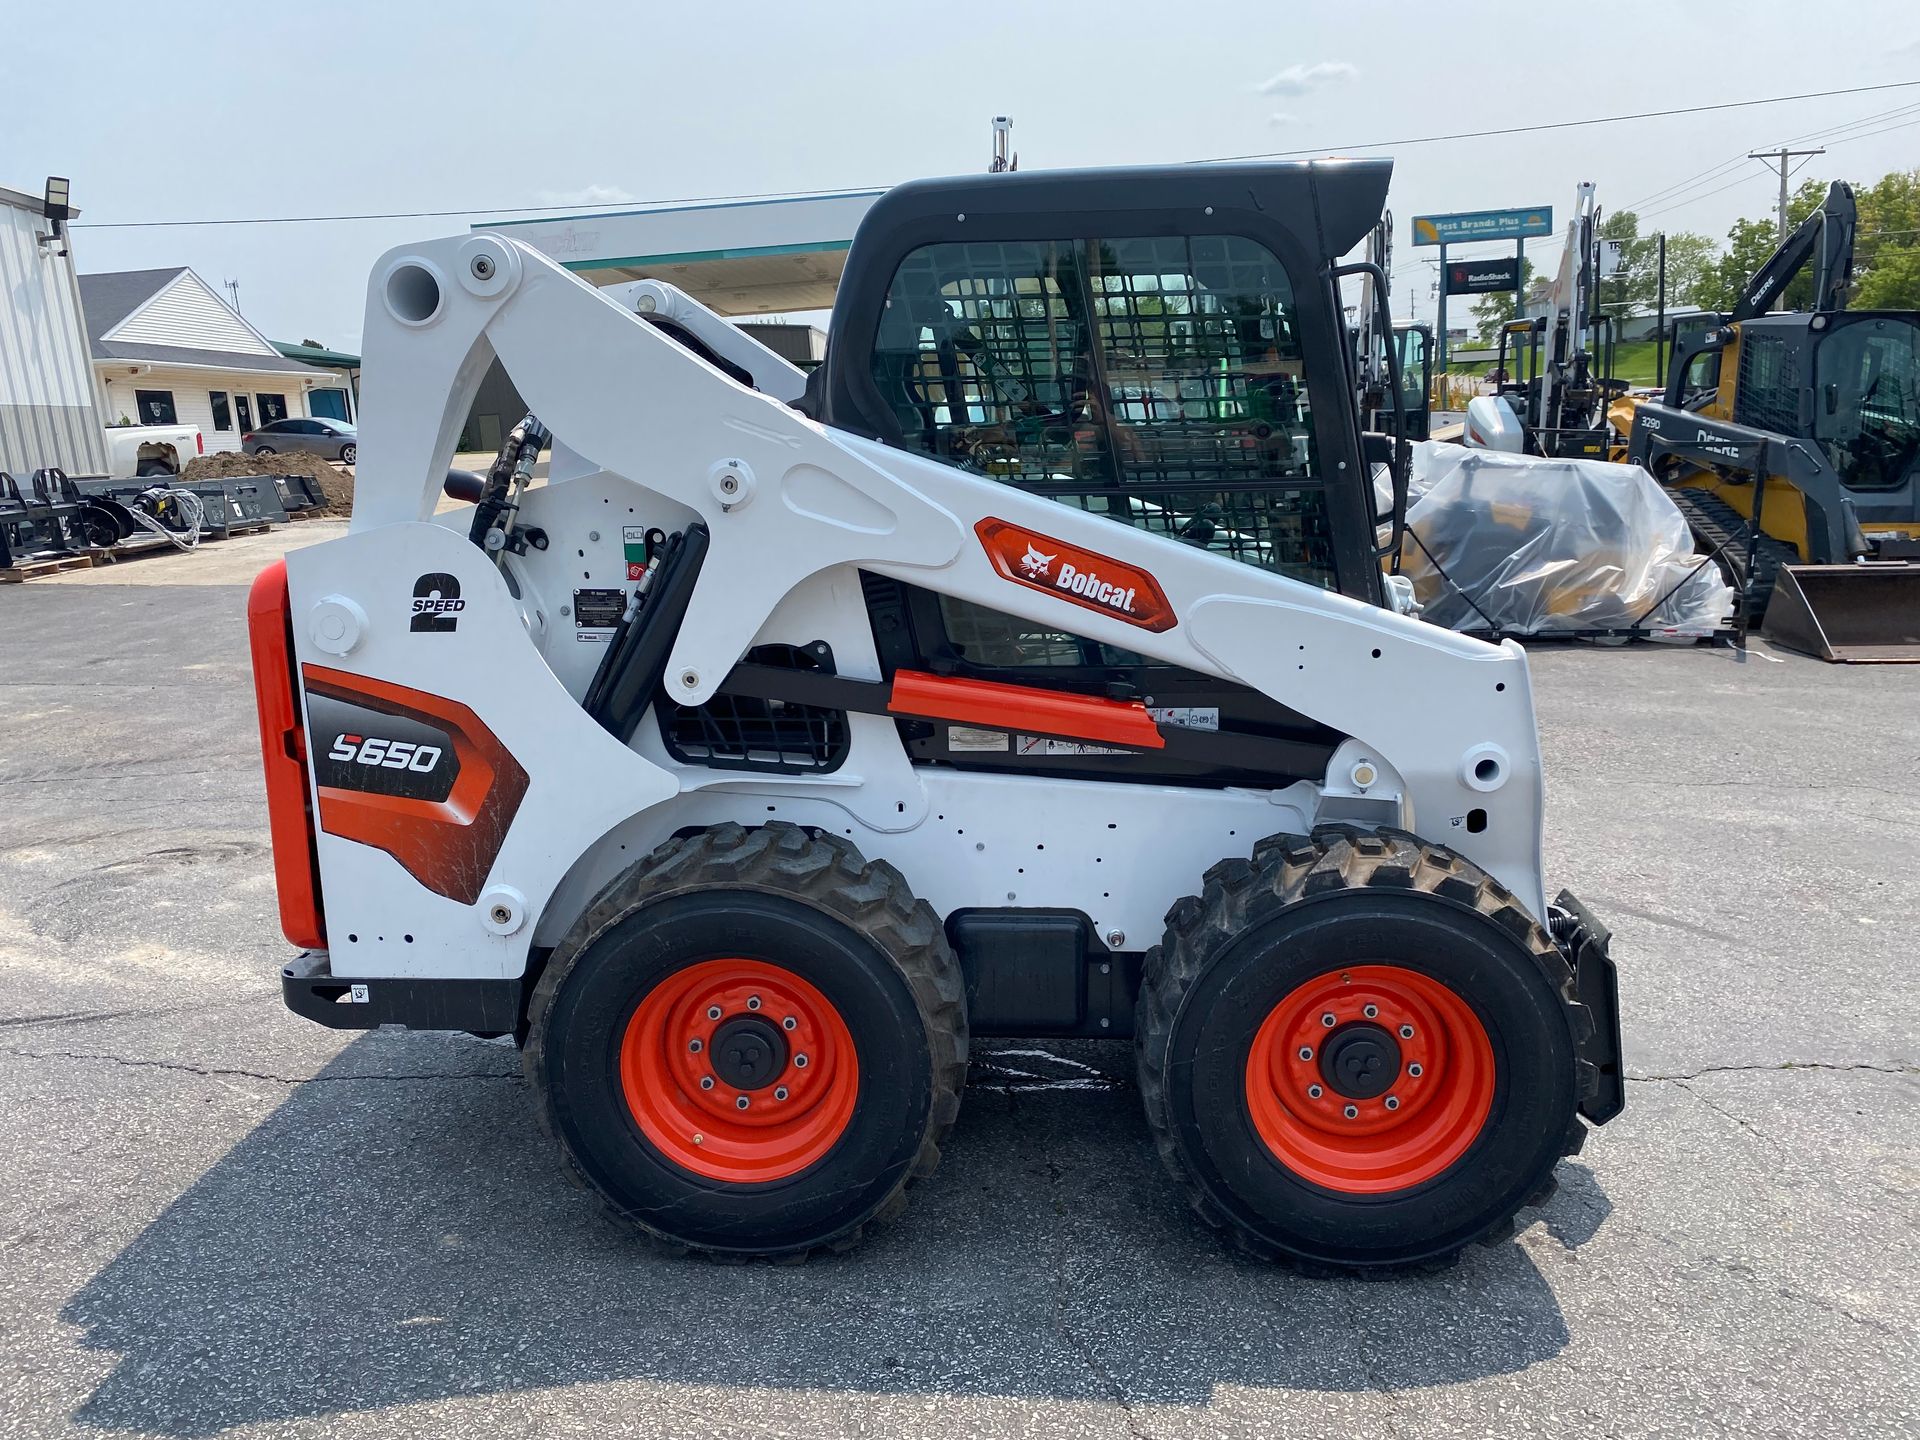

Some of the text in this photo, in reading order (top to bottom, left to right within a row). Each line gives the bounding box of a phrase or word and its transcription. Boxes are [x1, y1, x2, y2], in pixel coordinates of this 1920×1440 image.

[1435, 222, 1457, 230] Best
[1461, 219, 1495, 229] Brands
[1499, 217, 1519, 226] Plus
[1468, 272, 1511, 282] RadioShack
[1750, 276, 1775, 306] DEERE
[1641, 416, 1660, 429] 329D
[1055, 563, 1135, 612] Bobcat
[412, 600, 466, 612] SPEED
[328, 733, 442, 773] S650
